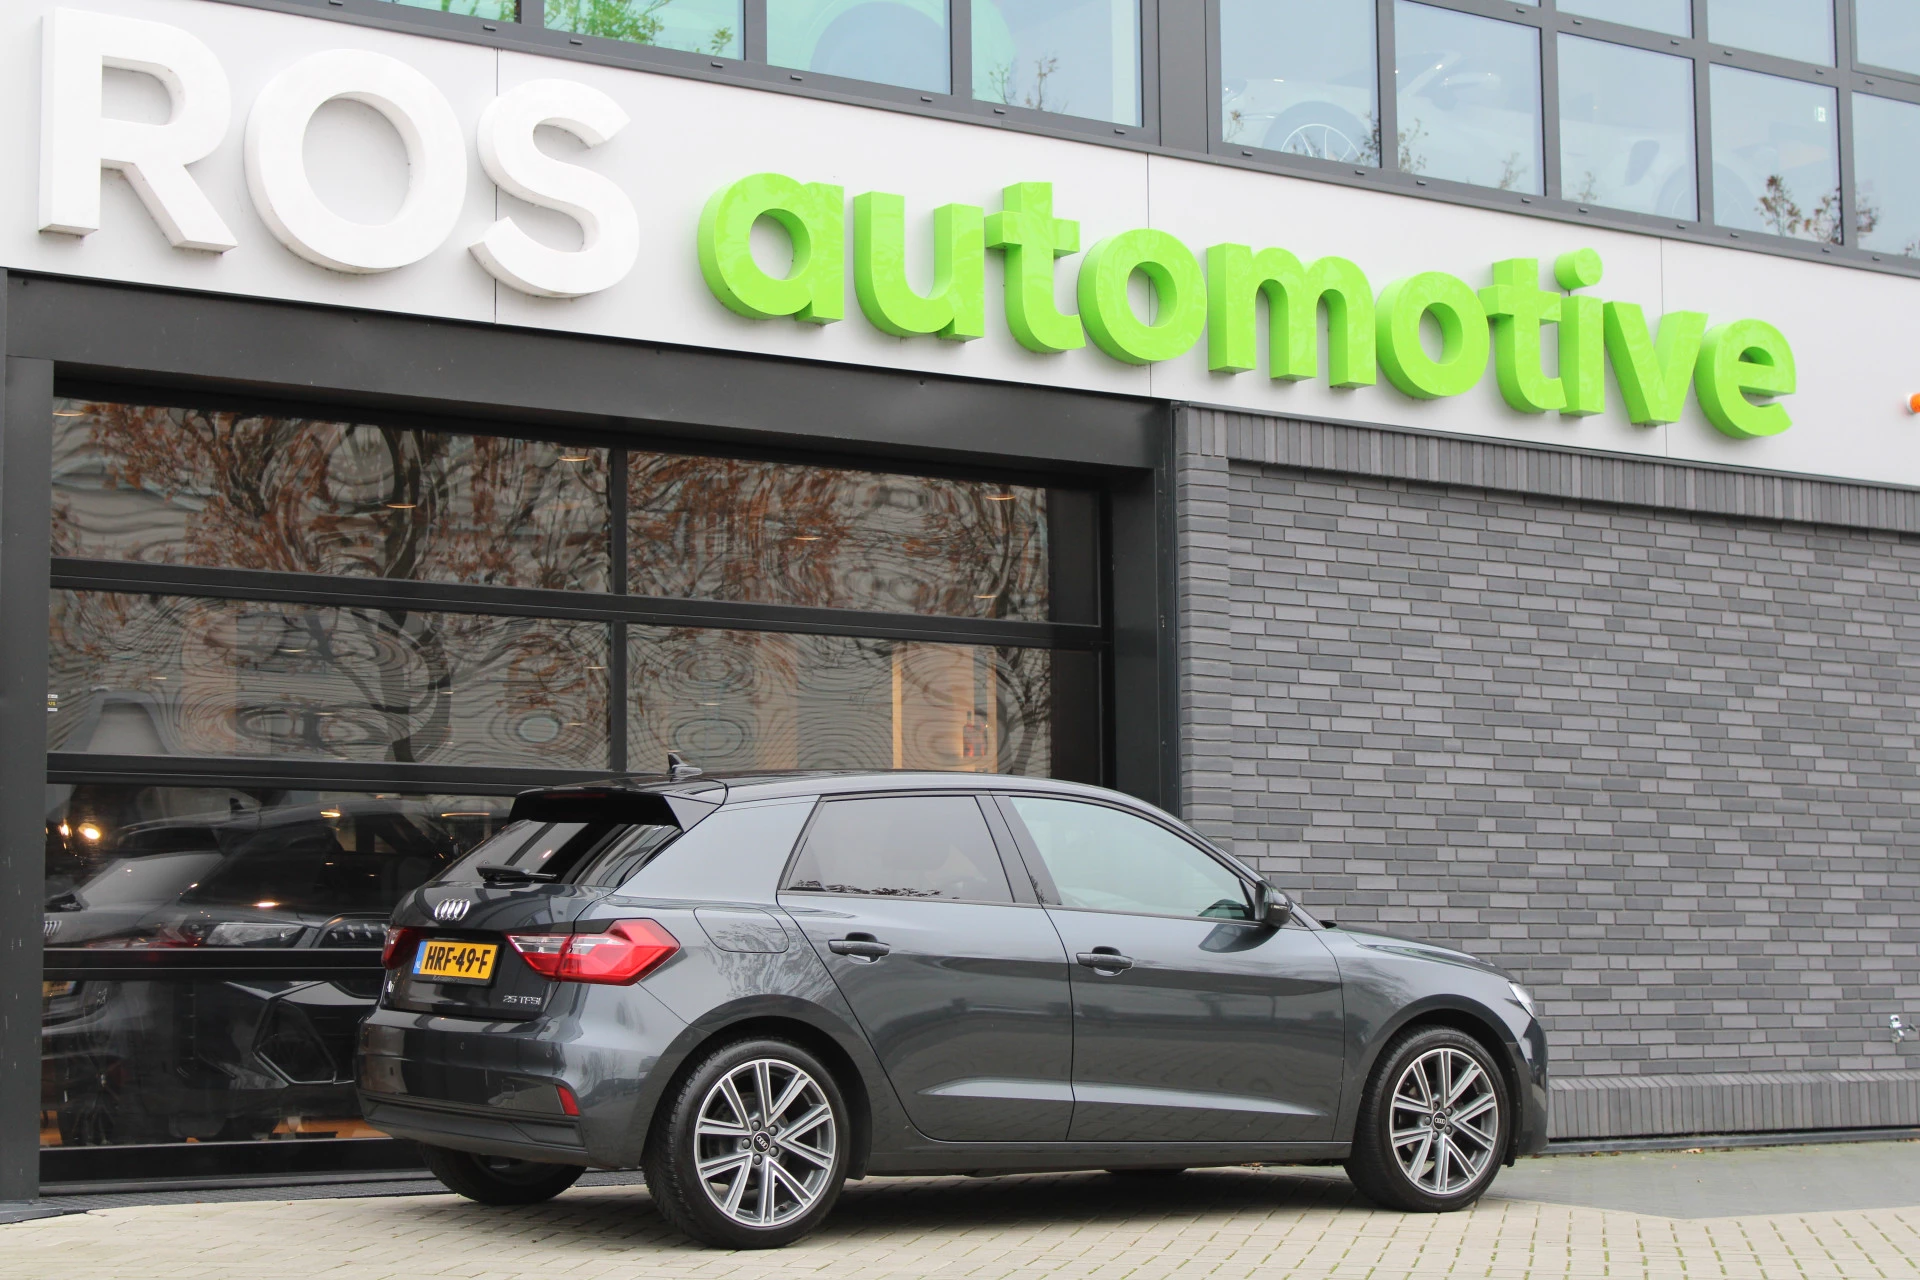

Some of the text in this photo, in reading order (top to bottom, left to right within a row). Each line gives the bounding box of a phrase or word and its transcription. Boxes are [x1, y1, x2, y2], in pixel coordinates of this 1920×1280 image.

[38, 7, 1796, 441] ROS automotive
[424, 945, 491, 974] HRF-49-F
